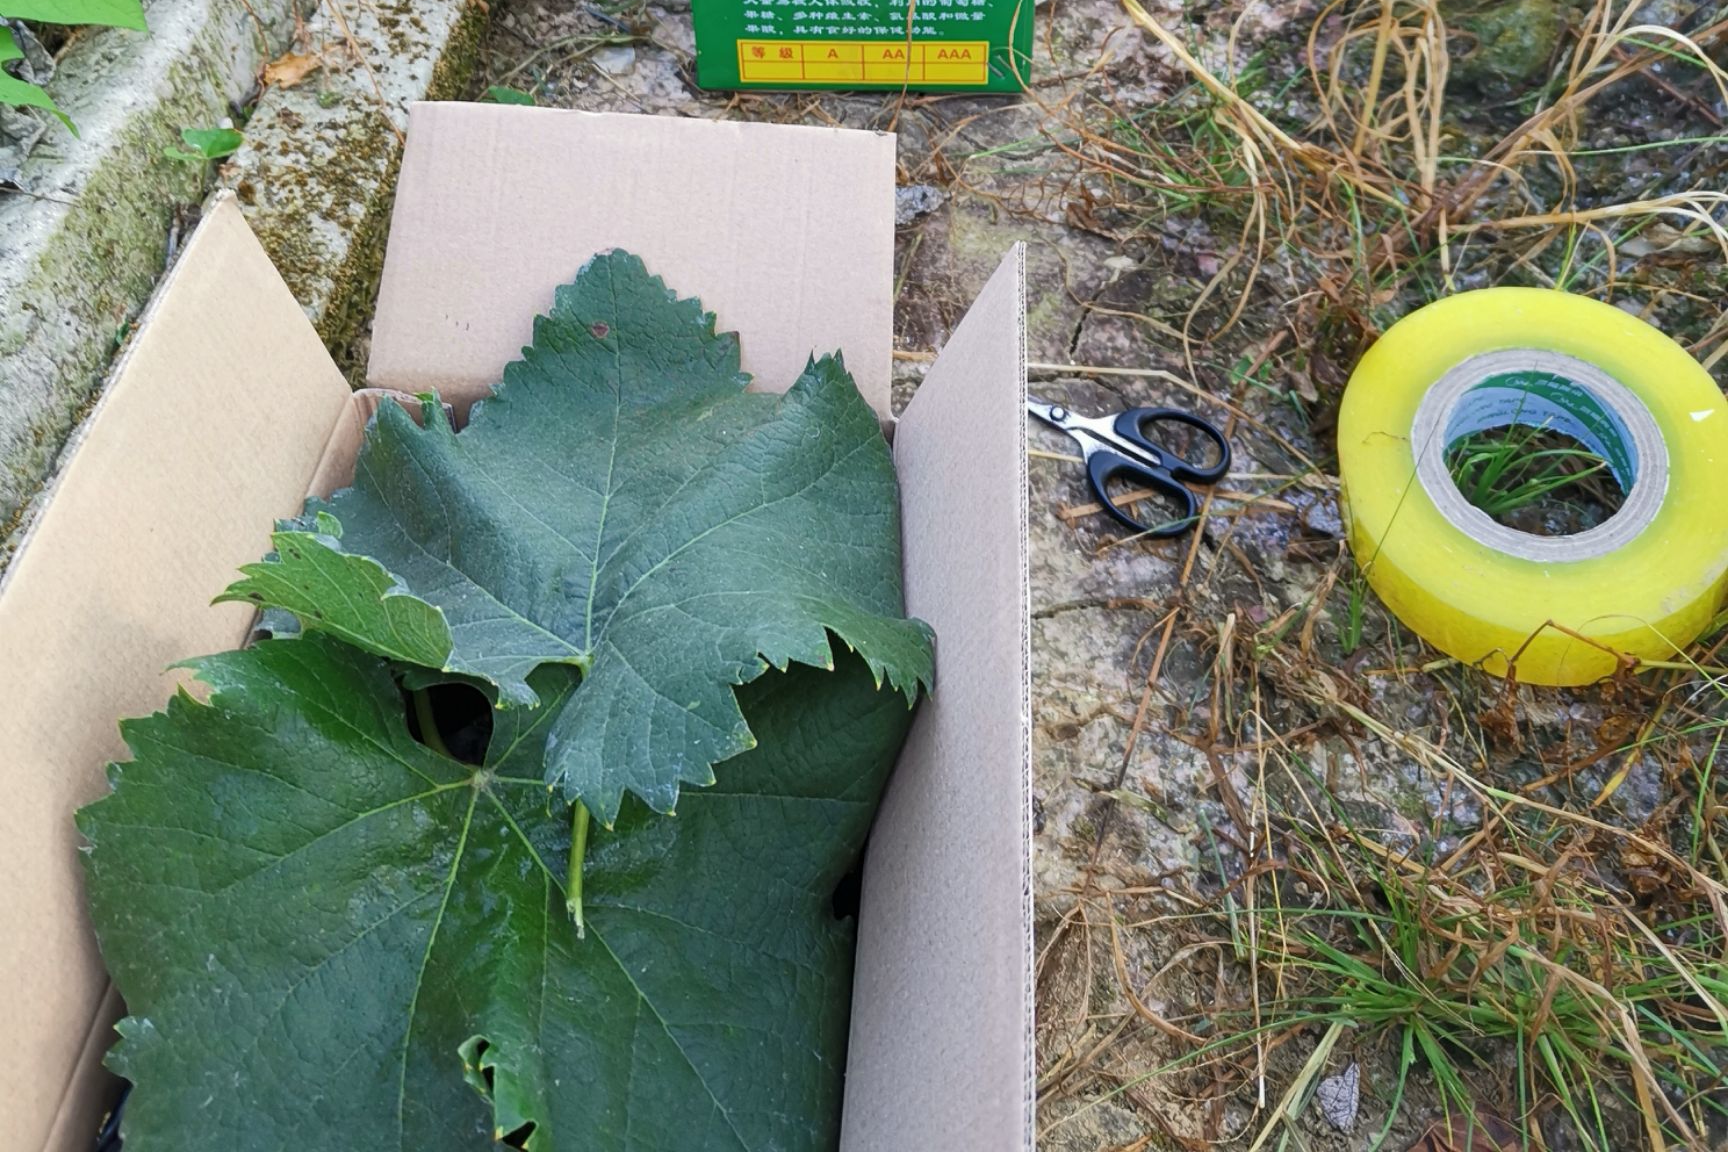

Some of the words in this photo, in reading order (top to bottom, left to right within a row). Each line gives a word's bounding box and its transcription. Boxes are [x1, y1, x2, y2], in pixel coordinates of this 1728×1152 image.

[827, 48, 839, 59] A
[882, 48, 905, 60] AA
[937, 48, 972, 60] AAA
